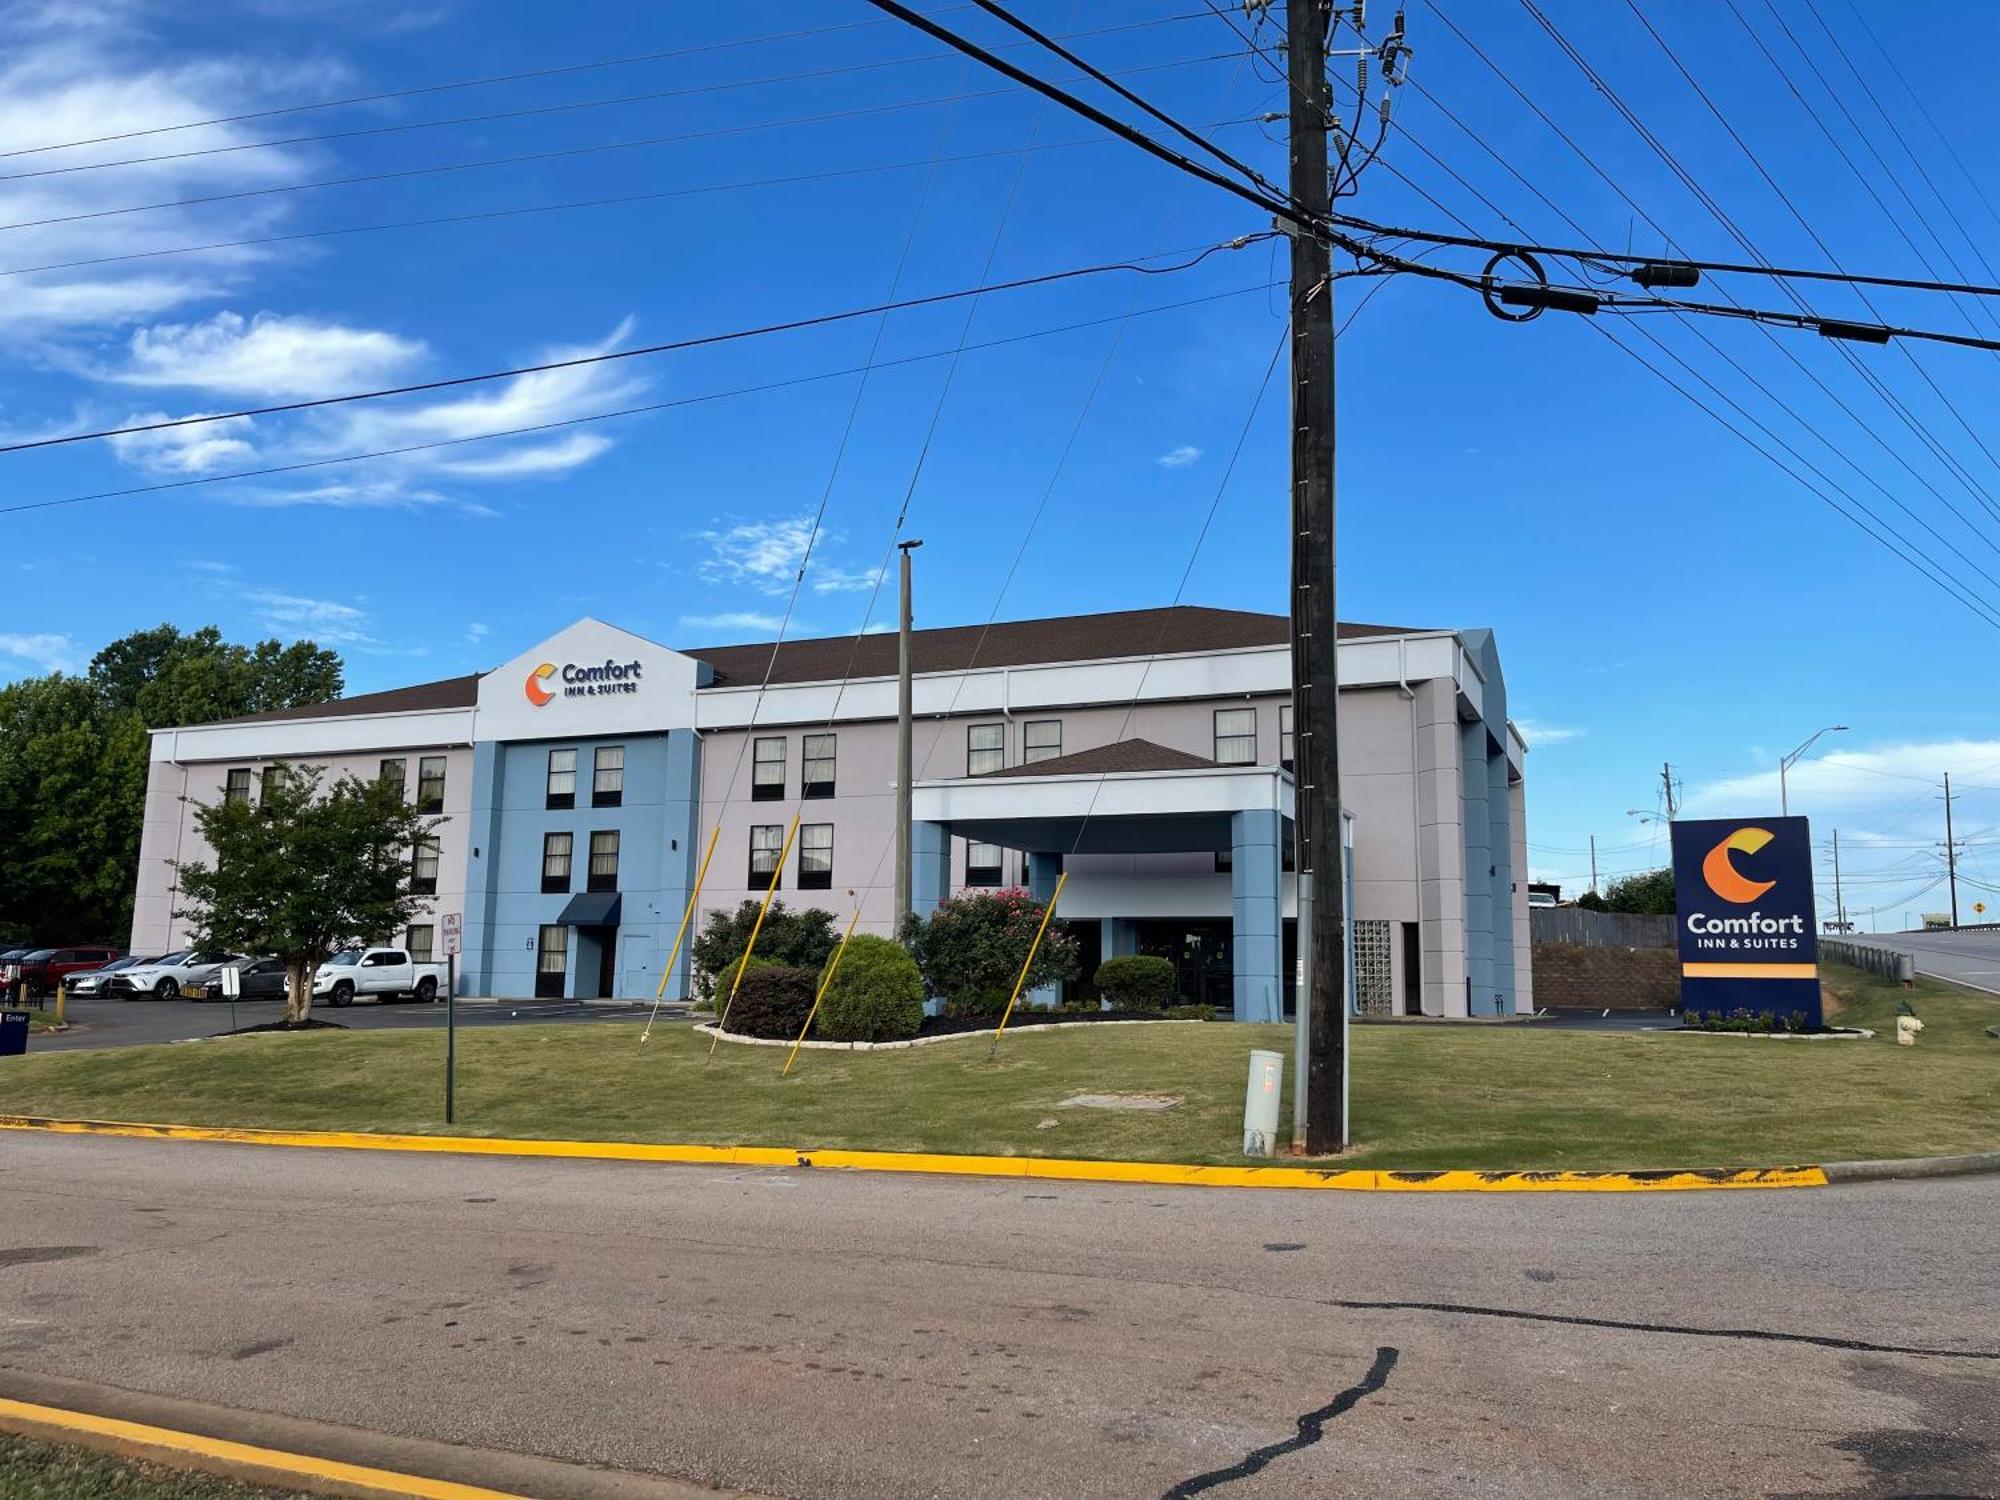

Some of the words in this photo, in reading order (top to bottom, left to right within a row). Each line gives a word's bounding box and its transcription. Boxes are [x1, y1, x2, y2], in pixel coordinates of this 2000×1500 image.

[562, 660, 641, 684] Comfort
[564, 686, 585, 697] INN
[587, 685, 596, 695] &
[597, 682, 636, 695] SUITES
[1687, 912, 1804, 934] Comfort
[1698, 939, 1725, 948] INN
[1729, 939, 1739, 949] &
[1743, 939, 1798, 949] SUITES
[5, 1014, 26, 1022] Enter
